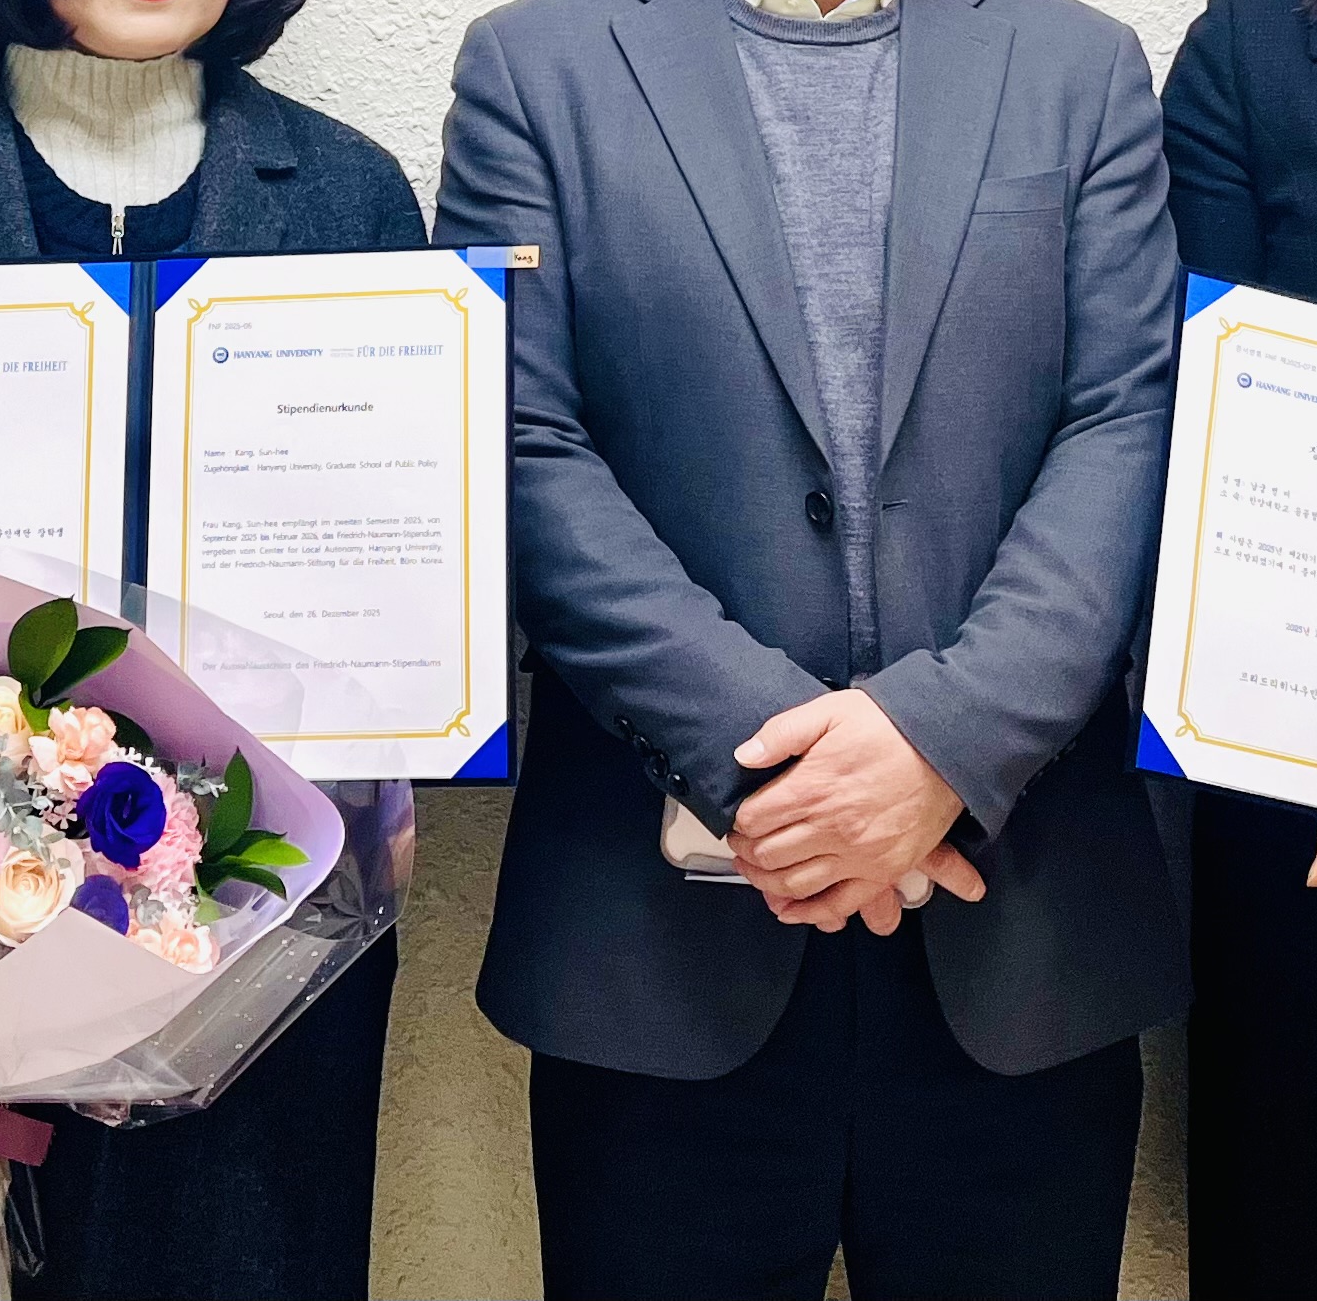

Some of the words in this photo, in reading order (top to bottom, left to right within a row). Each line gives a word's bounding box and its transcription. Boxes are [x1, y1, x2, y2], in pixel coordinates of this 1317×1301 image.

[233, 349, 272, 359] HANYANG
[275, 348, 323, 358] UNIVERSITY
[356, 344, 375, 357] FÜR
[378, 345, 395, 357] DIE
[398, 344, 444, 356] FREIHEIT
[2, 361, 19, 373] DIE
[22, 360, 68, 372] FREIHEIT
[276, 401, 373, 415] Stipendienurkunde
